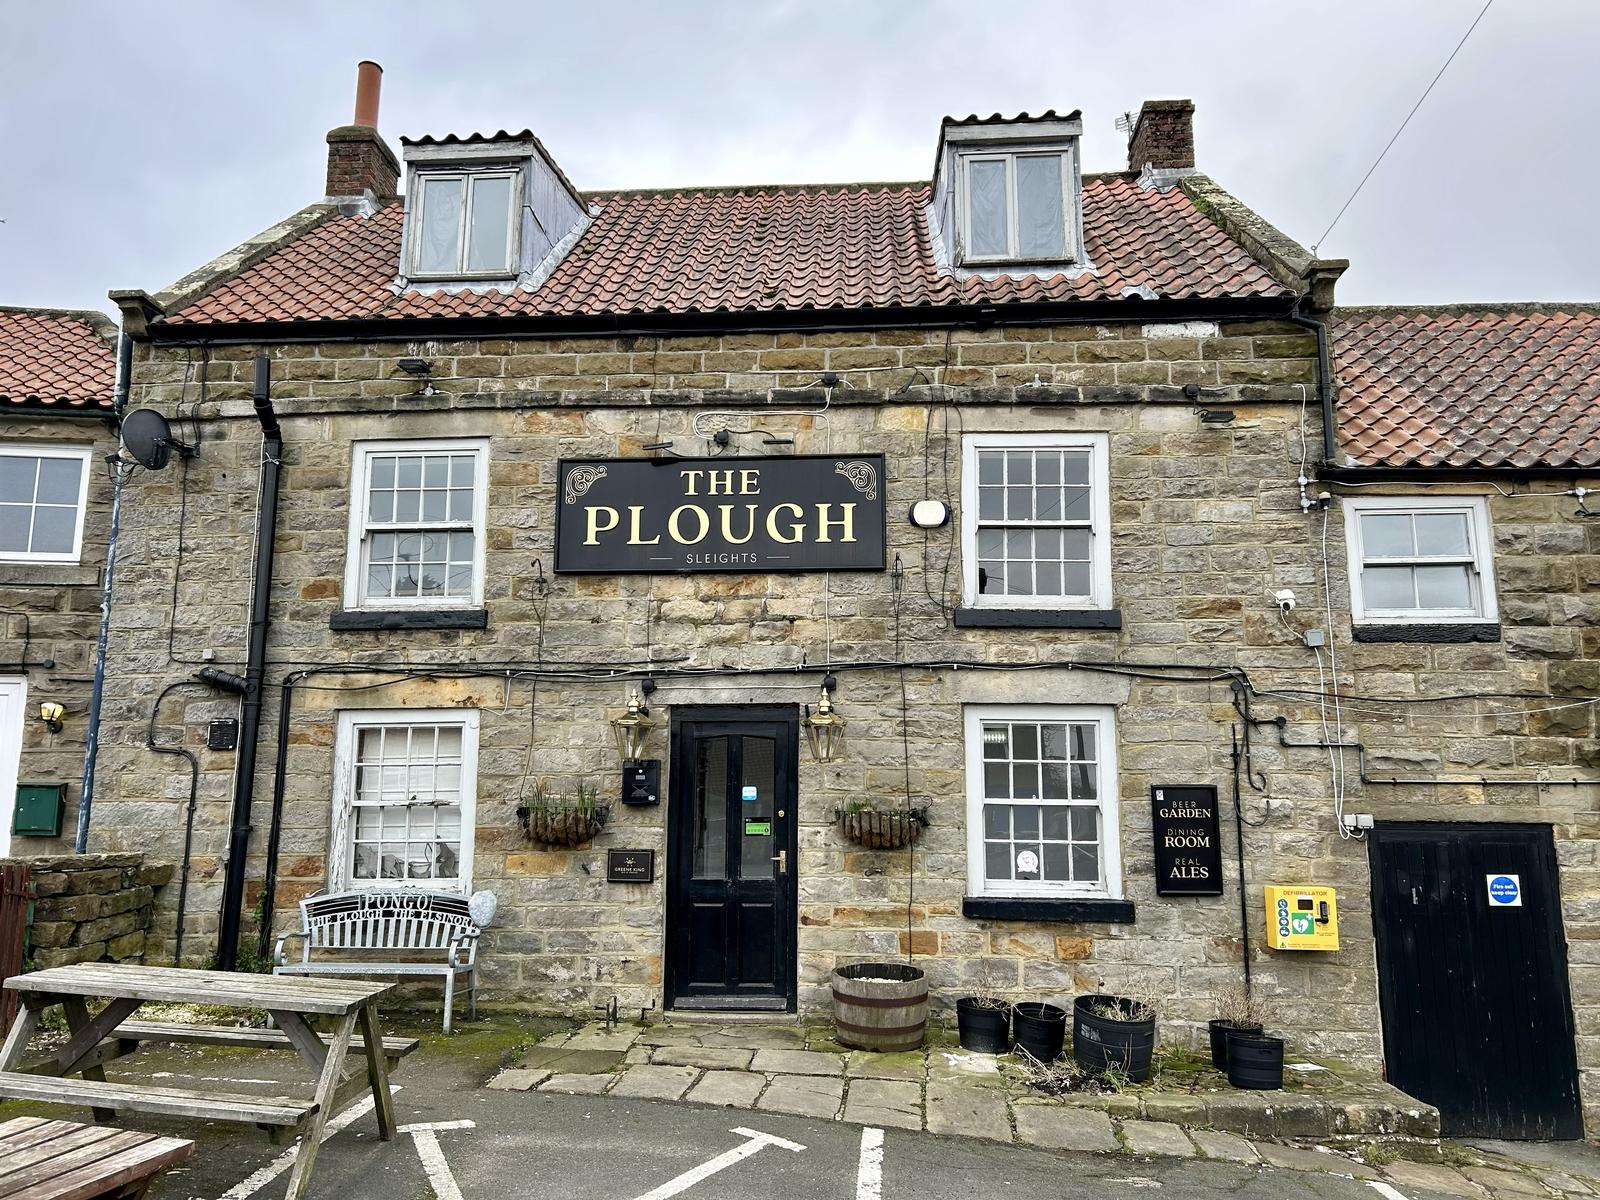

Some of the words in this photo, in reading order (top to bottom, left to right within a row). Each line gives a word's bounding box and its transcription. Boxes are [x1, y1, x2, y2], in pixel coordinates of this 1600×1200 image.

[680, 469, 761, 496] THE
[582, 502, 858, 546] PLOUGH
[686, 552, 758, 564] SLEIGHTS
[1160, 808, 1211, 818] GARDEN
[1167, 828, 1205, 836] DINING
[1164, 836, 1210, 847] ROOM
[1170, 866, 1209, 878] ALES
[363, 893, 429, 910] PONGO
[308, 915, 332, 927] THE
[337, 909, 383, 923] PLOUGH
[392, 909, 415, 919] THE
